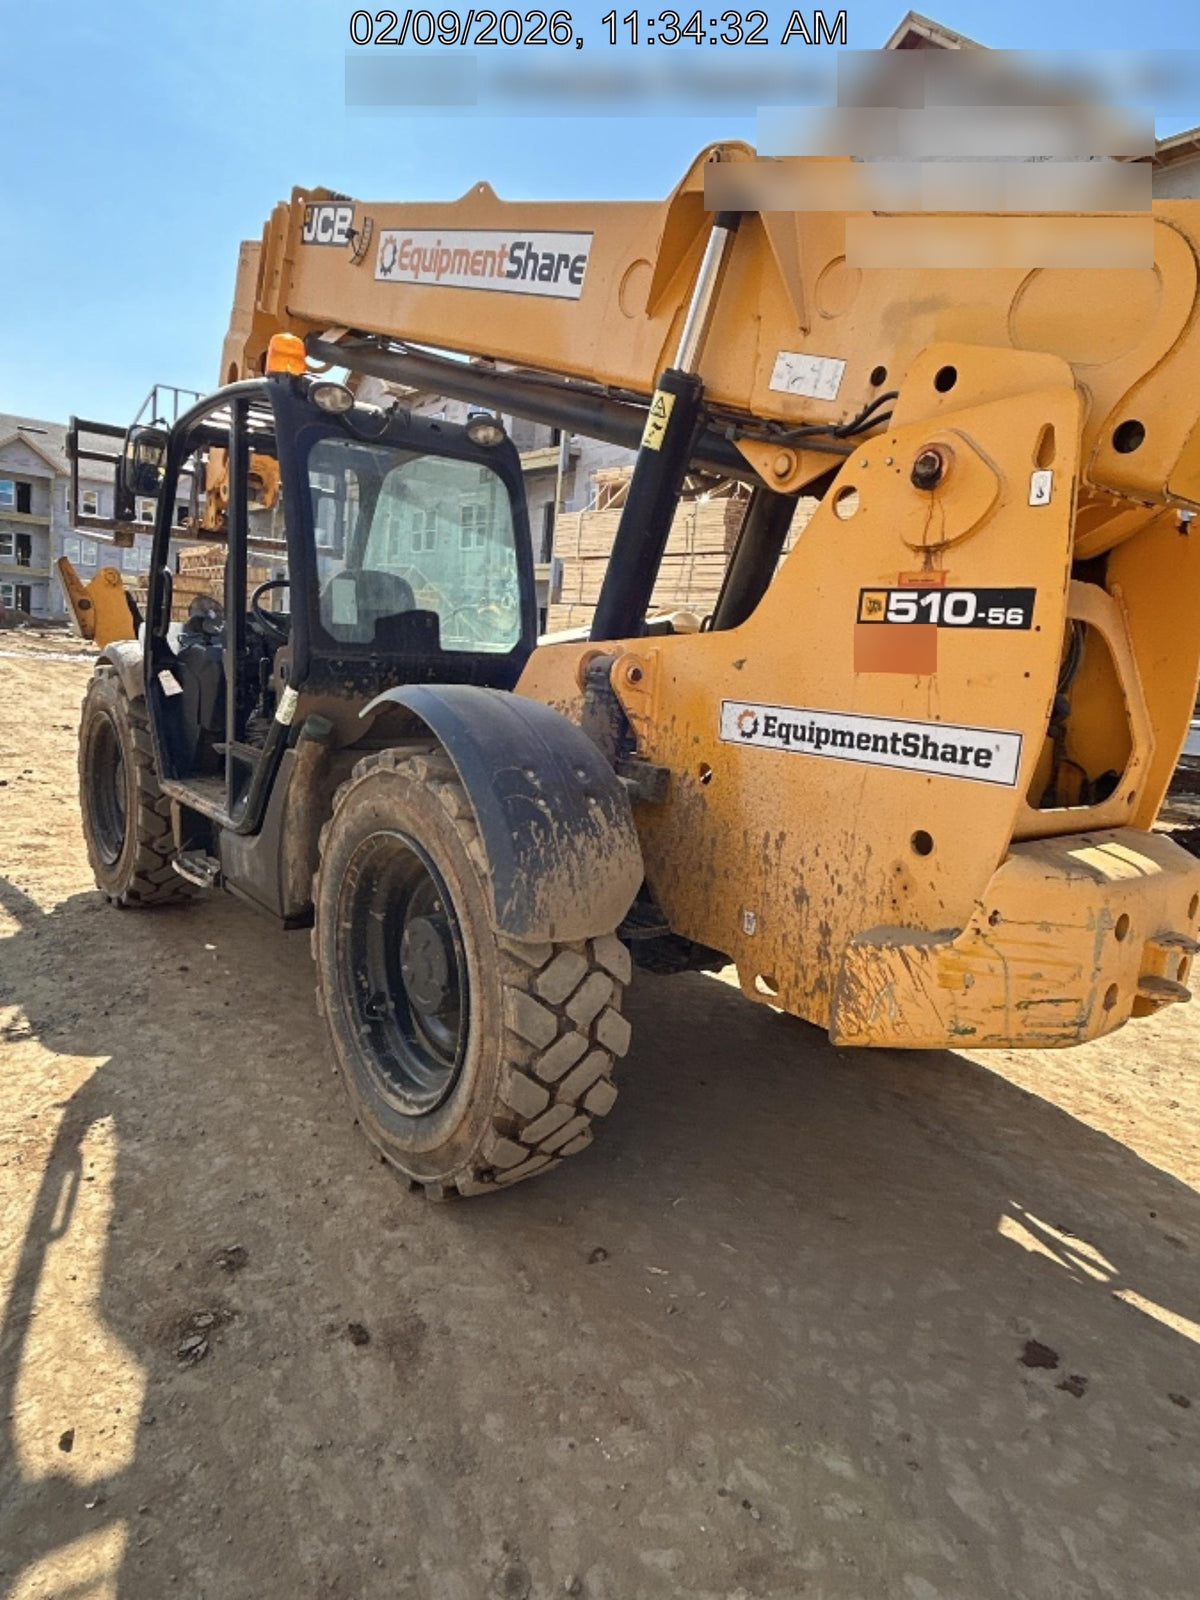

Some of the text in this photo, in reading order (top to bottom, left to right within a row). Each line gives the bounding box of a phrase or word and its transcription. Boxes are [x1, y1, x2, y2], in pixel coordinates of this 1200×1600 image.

[303, 207, 353, 243] JCB
[400, 238, 588, 285] EquipmentShare
[886, 591, 1024, 625] 510-56
[762, 715, 993, 769] EquipmentShare
